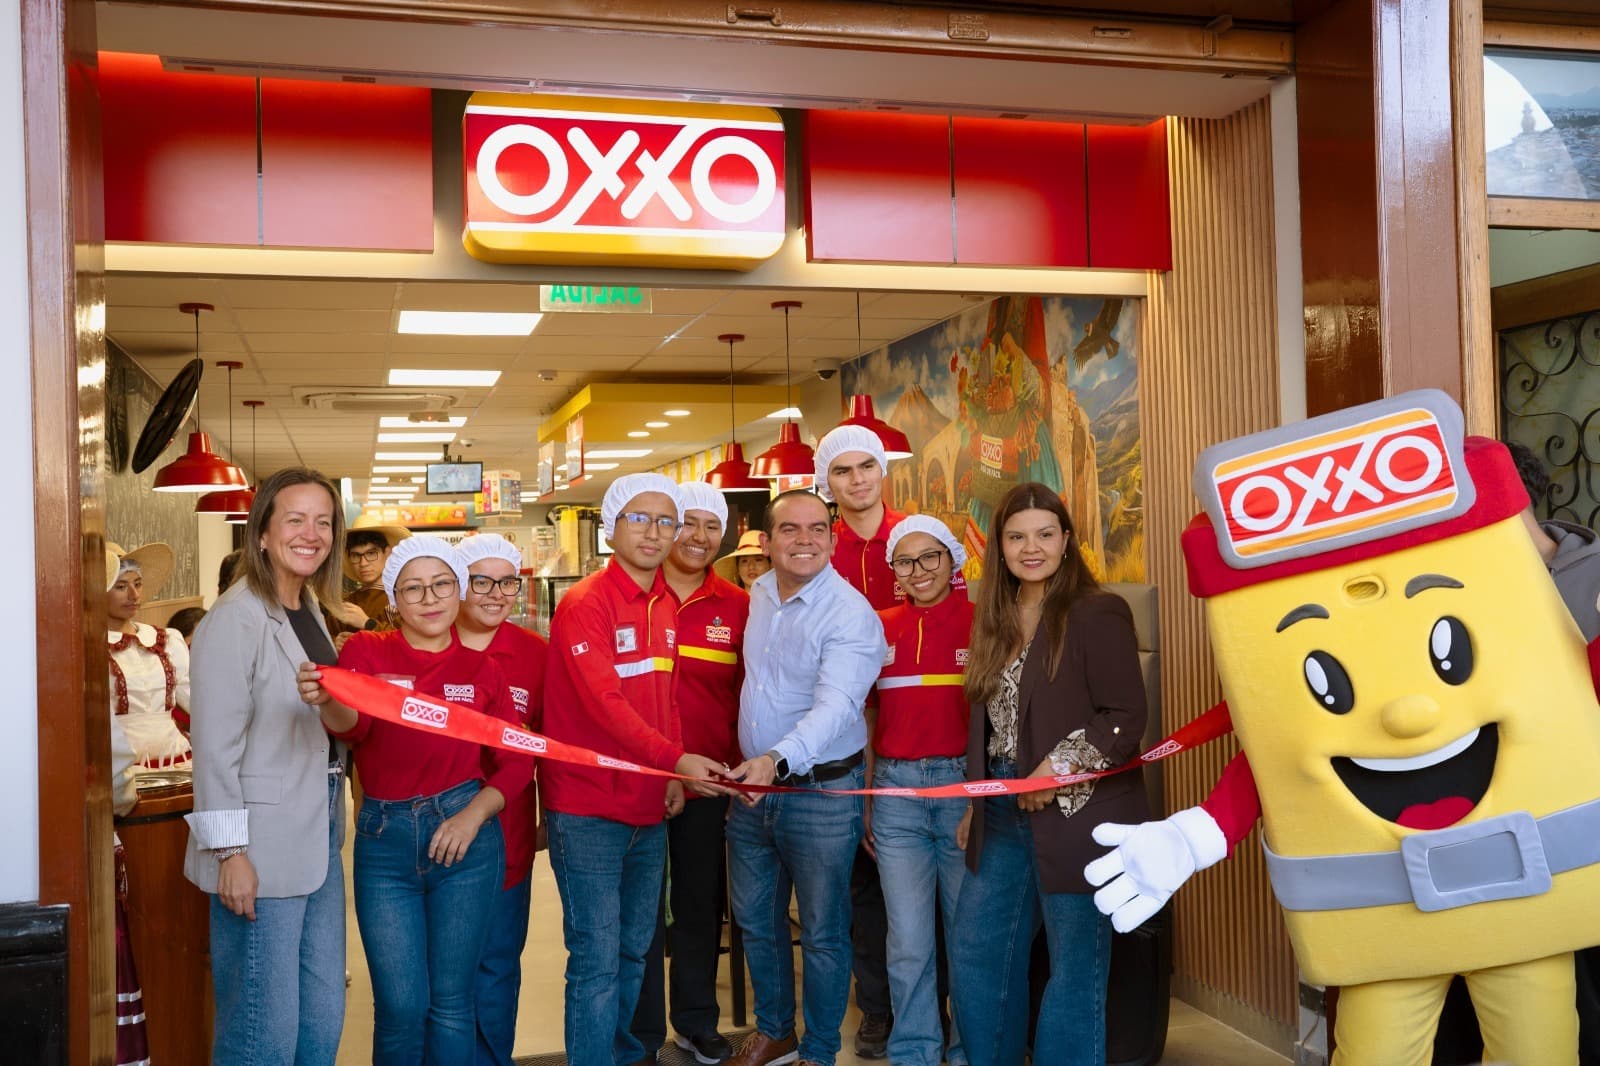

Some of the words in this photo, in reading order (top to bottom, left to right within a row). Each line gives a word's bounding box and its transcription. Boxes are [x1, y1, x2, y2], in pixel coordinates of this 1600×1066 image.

[476, 121, 777, 225] OXXO
[981, 441, 1002, 462] OXXO
[1229, 435, 1442, 533] OXXO
[445, 686, 474, 696] OXXO
[404, 702, 447, 723] OXXO
[504, 731, 544, 749] OXXO
